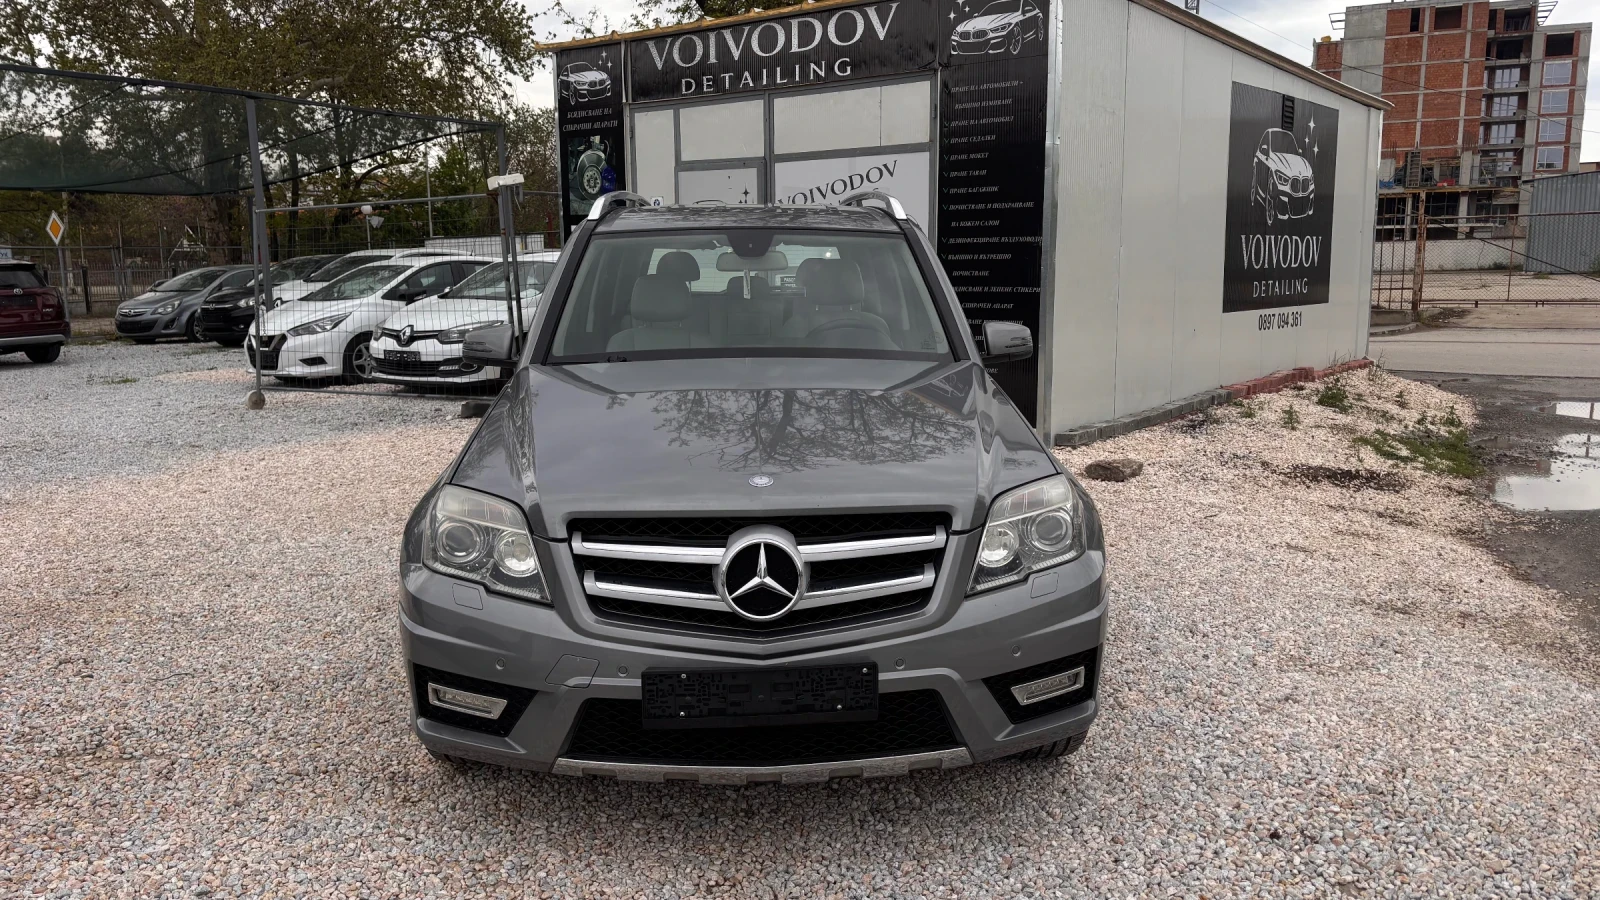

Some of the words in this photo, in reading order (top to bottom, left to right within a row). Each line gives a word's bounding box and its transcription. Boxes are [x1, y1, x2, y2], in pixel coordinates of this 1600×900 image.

[645, 2, 900, 70] VOIVODOV
[681, 57, 852, 94] DETAILING
[980, 80, 1018, 90] АВТОМОБИЛИ
[592, 120, 618, 128] АПАРАТИ
[979, 116, 1014, 124] АВТОМОБИЛ
[1240, 234, 1322, 270] VOIVODOV
[1253, 278, 1308, 298] DETAILING
[1258, 313, 1276, 331] 0897
[1277, 312, 1289, 329] 094
[1290, 311, 1302, 328] 361
